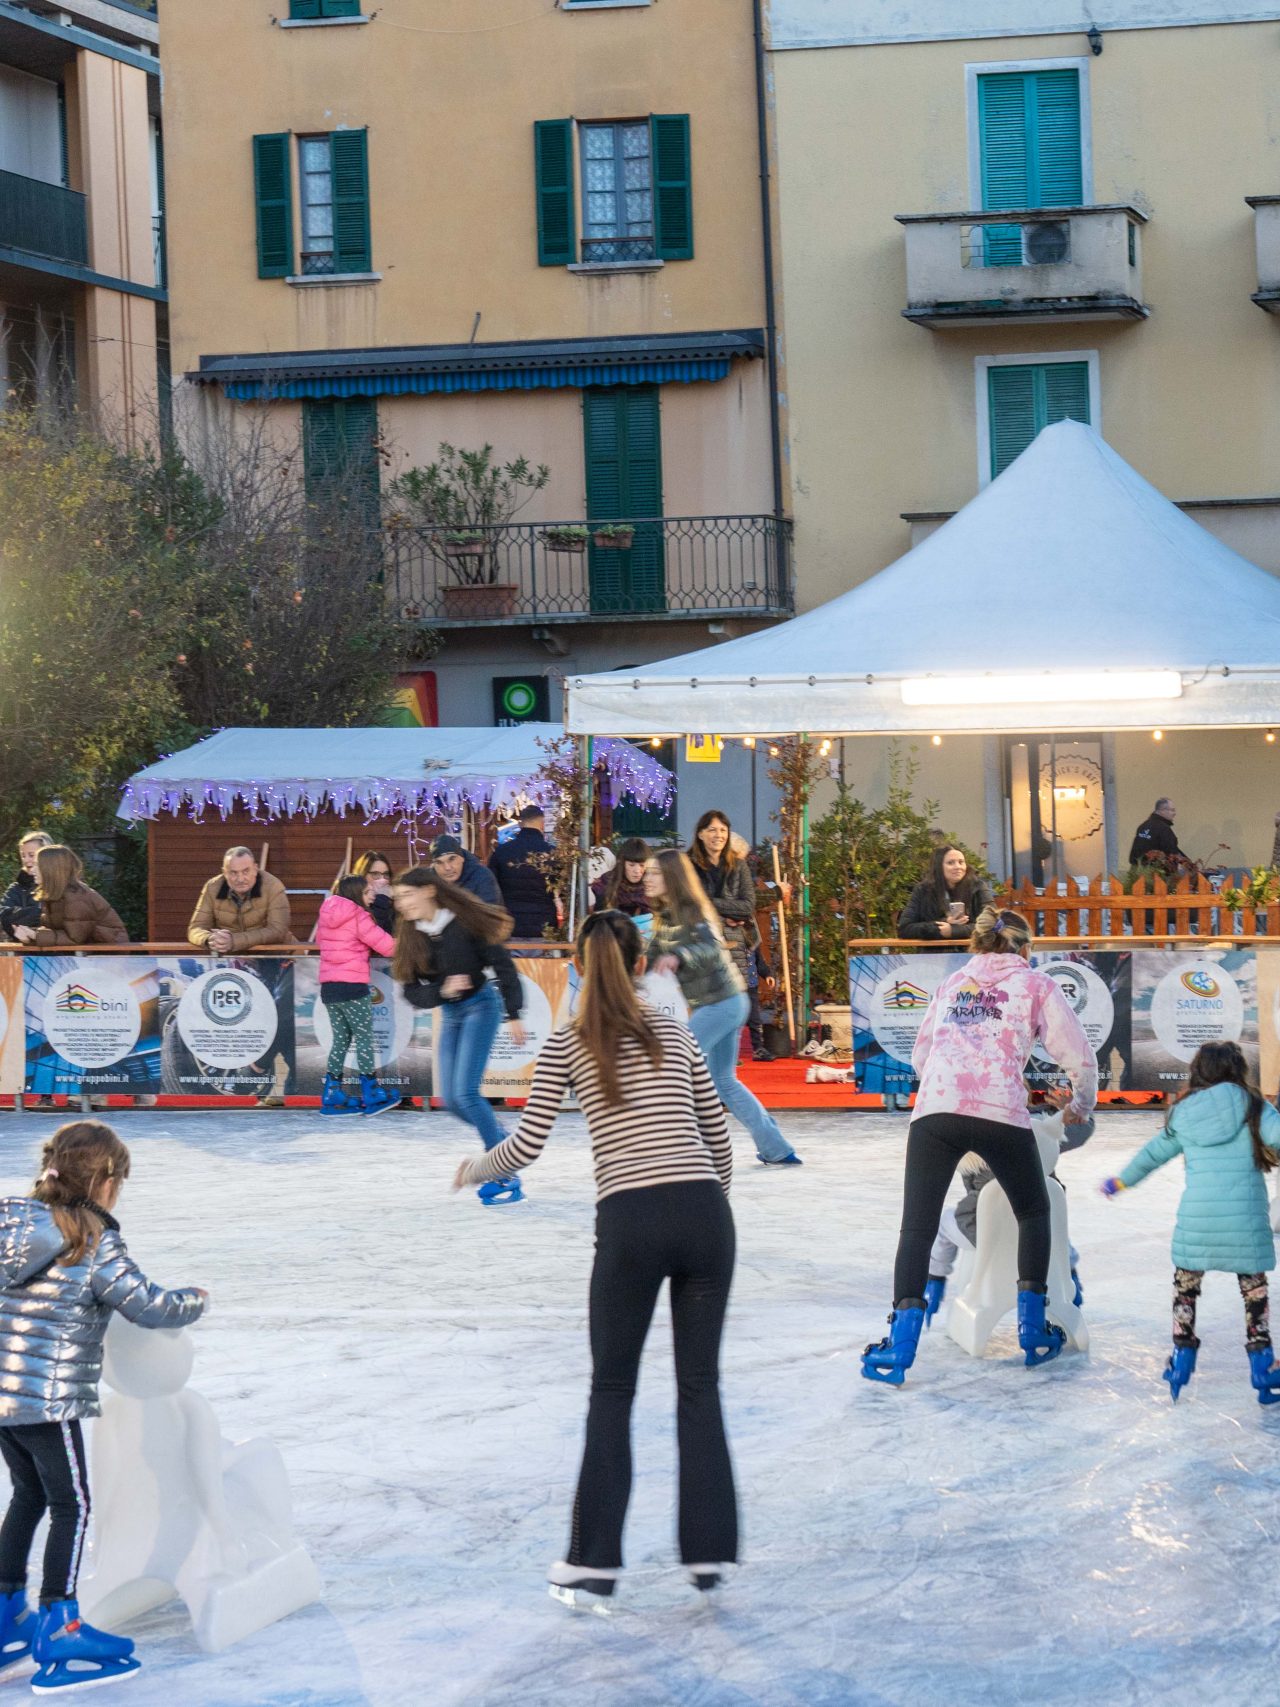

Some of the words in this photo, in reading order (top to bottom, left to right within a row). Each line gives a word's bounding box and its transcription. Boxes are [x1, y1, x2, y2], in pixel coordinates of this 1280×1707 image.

[101, 999, 128, 1012] bini
[1176, 999, 1223, 1010] SATURNO
[55, 1074, 129, 1084] www.gruppobini.it
